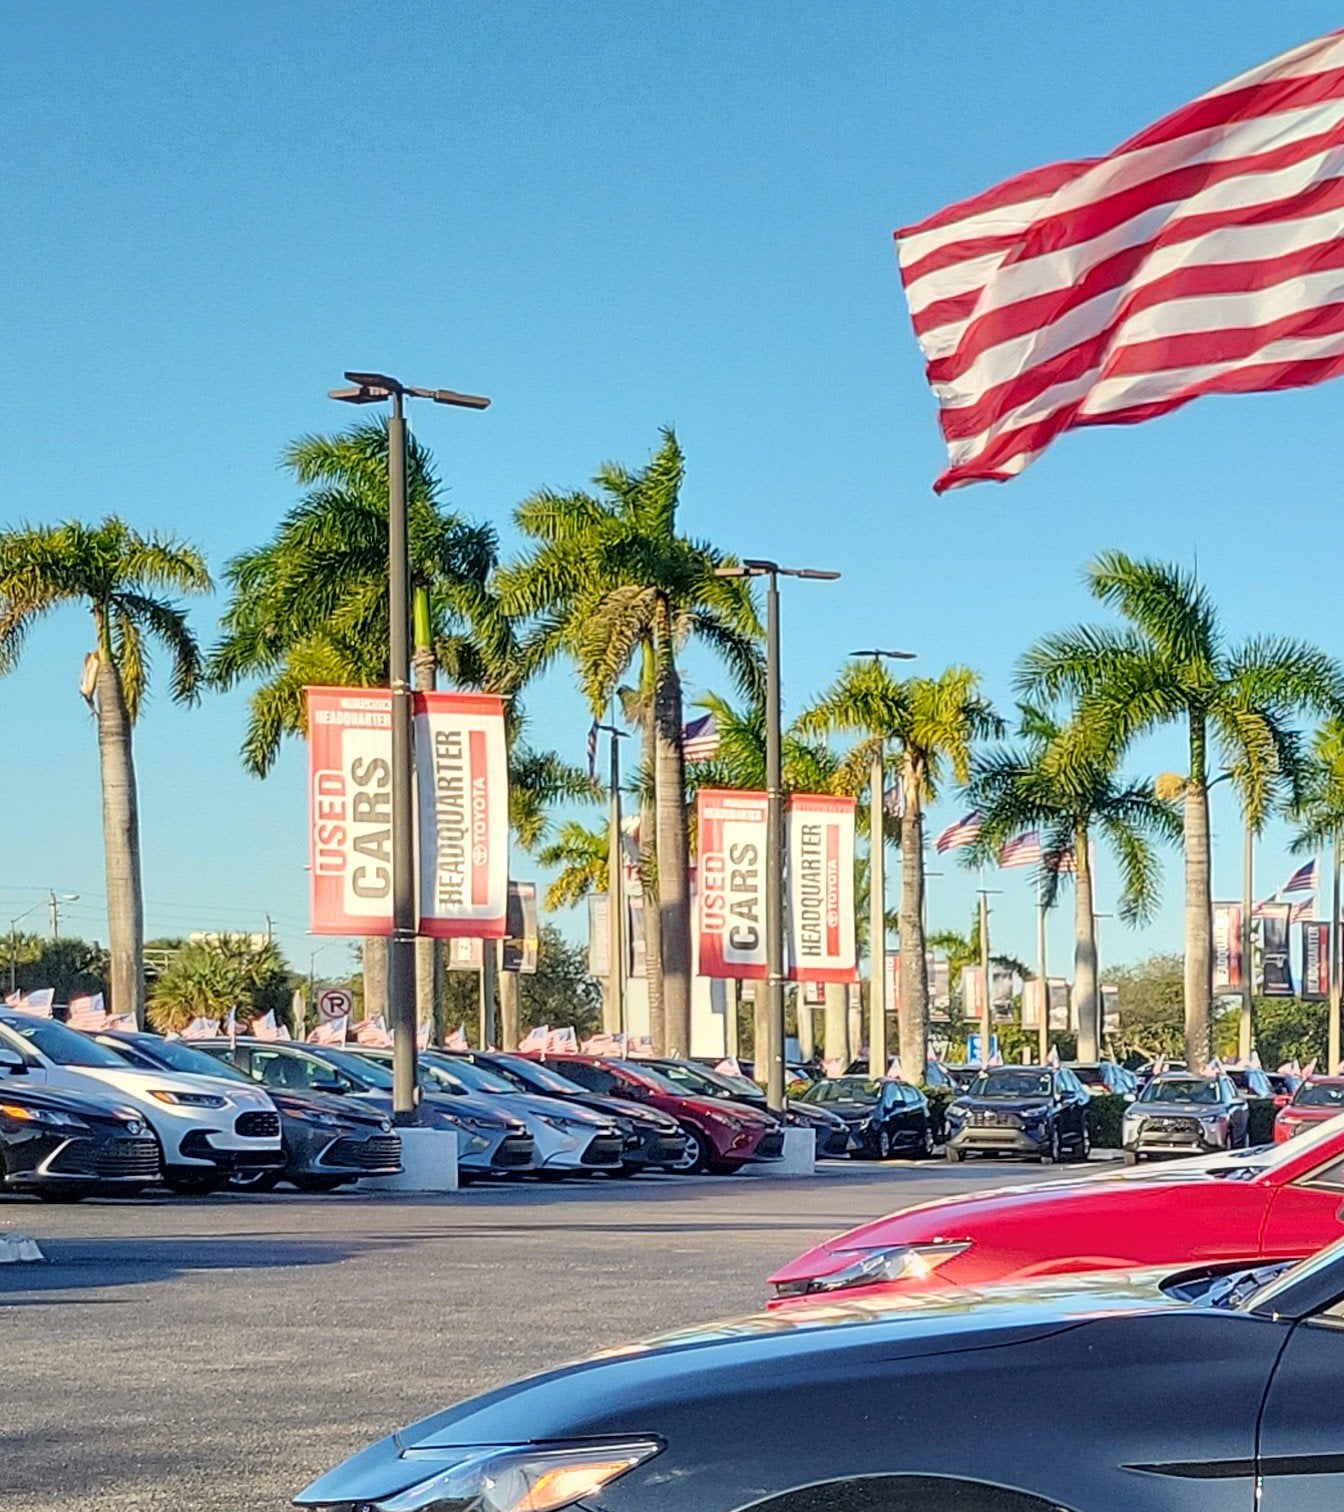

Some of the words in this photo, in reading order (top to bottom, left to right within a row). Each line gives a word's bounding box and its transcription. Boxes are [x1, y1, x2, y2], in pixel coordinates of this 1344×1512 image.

[317, 772, 347, 873] USED
[351, 757, 391, 899] CARS
[435, 730, 470, 907] HEADQUARTER
[472, 777, 486, 842] TOYOTA
[703, 855, 725, 930] USED
[729, 843, 760, 951] CARS
[801, 824, 824, 957] HEADQUARTER
